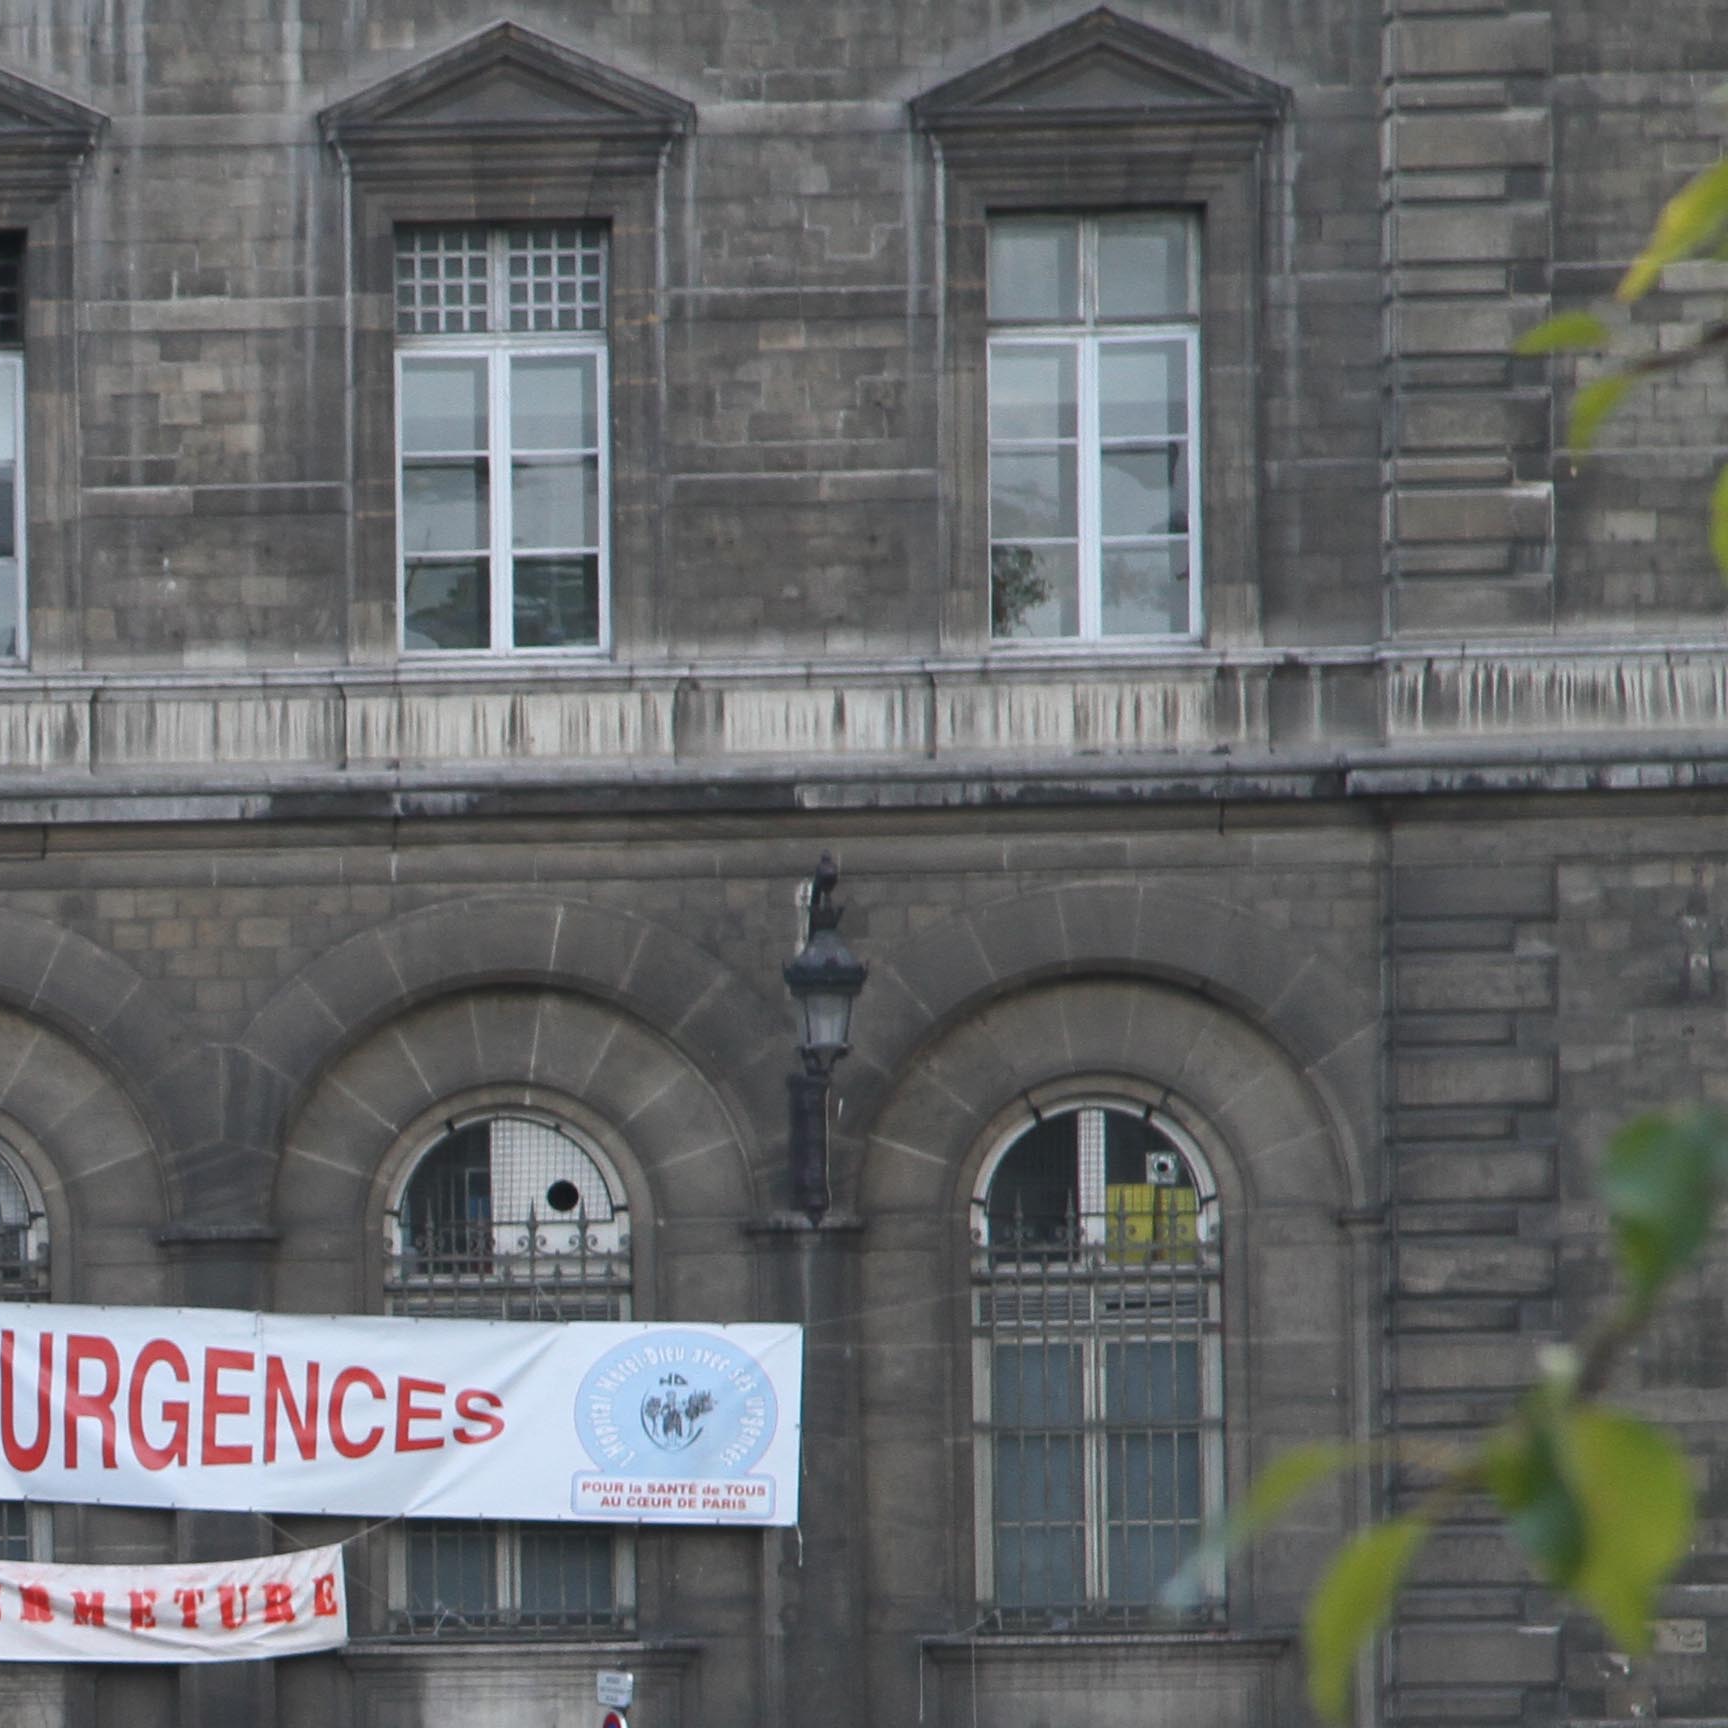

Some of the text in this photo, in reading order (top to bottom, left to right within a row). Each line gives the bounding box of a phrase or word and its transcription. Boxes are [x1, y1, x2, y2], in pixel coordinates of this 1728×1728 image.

[692, 1346, 731, 1372] avec
[728, 1367, 757, 1392] ses
[0, 1330, 505, 1473] URGENCES
[581, 1481, 766, 1497] POUR la SANTÉ de TOUS
[600, 1495, 622, 1507] AU
[677, 1497, 697, 1509] DE
[702, 1498, 747, 1510] PARIS
